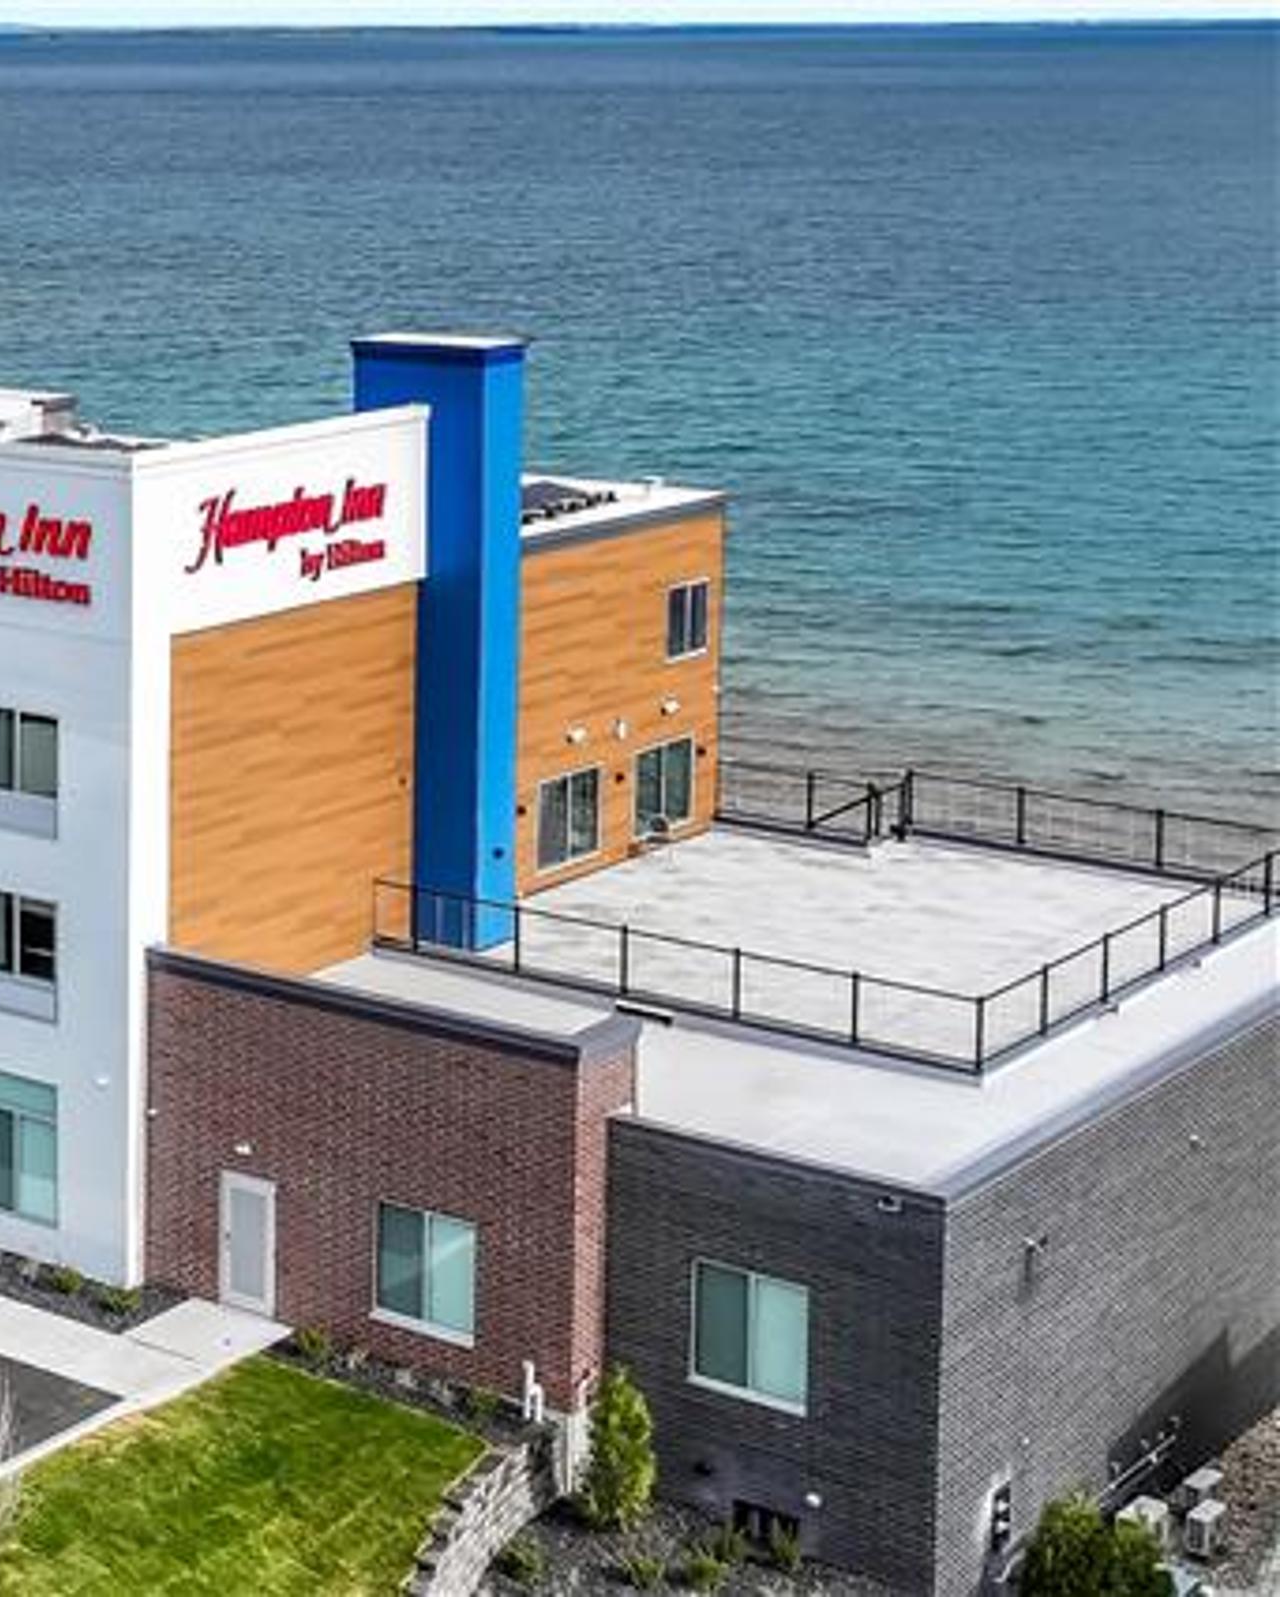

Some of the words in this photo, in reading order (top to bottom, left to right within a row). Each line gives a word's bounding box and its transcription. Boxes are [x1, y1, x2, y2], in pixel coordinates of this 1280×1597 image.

[20, 504, 93, 559] Inn
[185, 488, 341, 573] Hampton
[342, 478, 387, 523] Inn
[302, 549, 324, 581] by
[327, 539, 385, 570] Hilton
